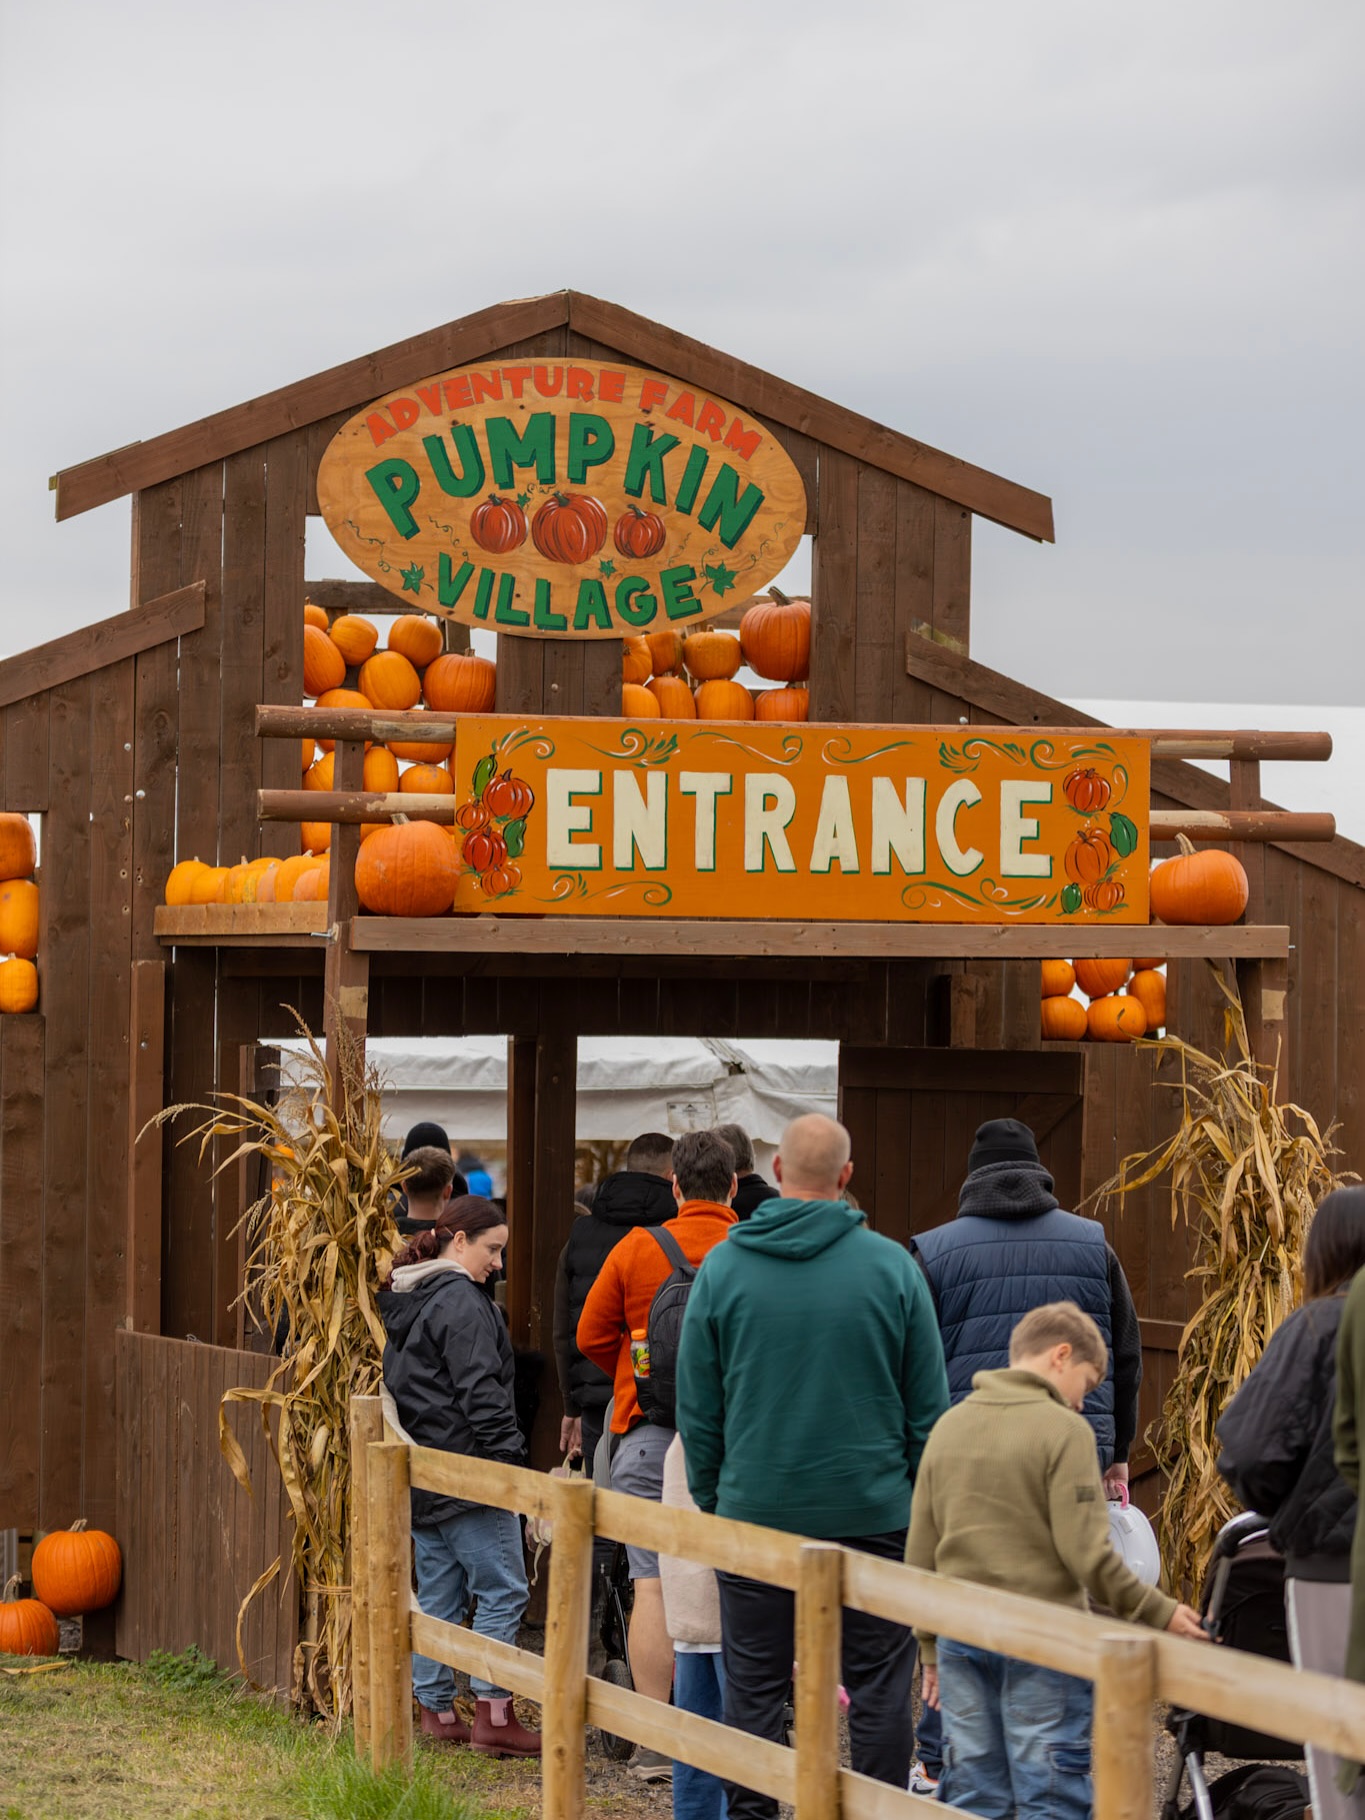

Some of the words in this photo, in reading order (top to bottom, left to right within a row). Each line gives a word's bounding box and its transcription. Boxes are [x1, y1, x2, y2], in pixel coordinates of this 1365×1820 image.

[365, 366, 625, 448] ADVENTURE
[638, 378, 763, 461] FARM
[364, 412, 766, 550] PUMPKIN
[437, 551, 704, 631] VILLAGE
[546, 768, 1054, 878] ENTRANCE
